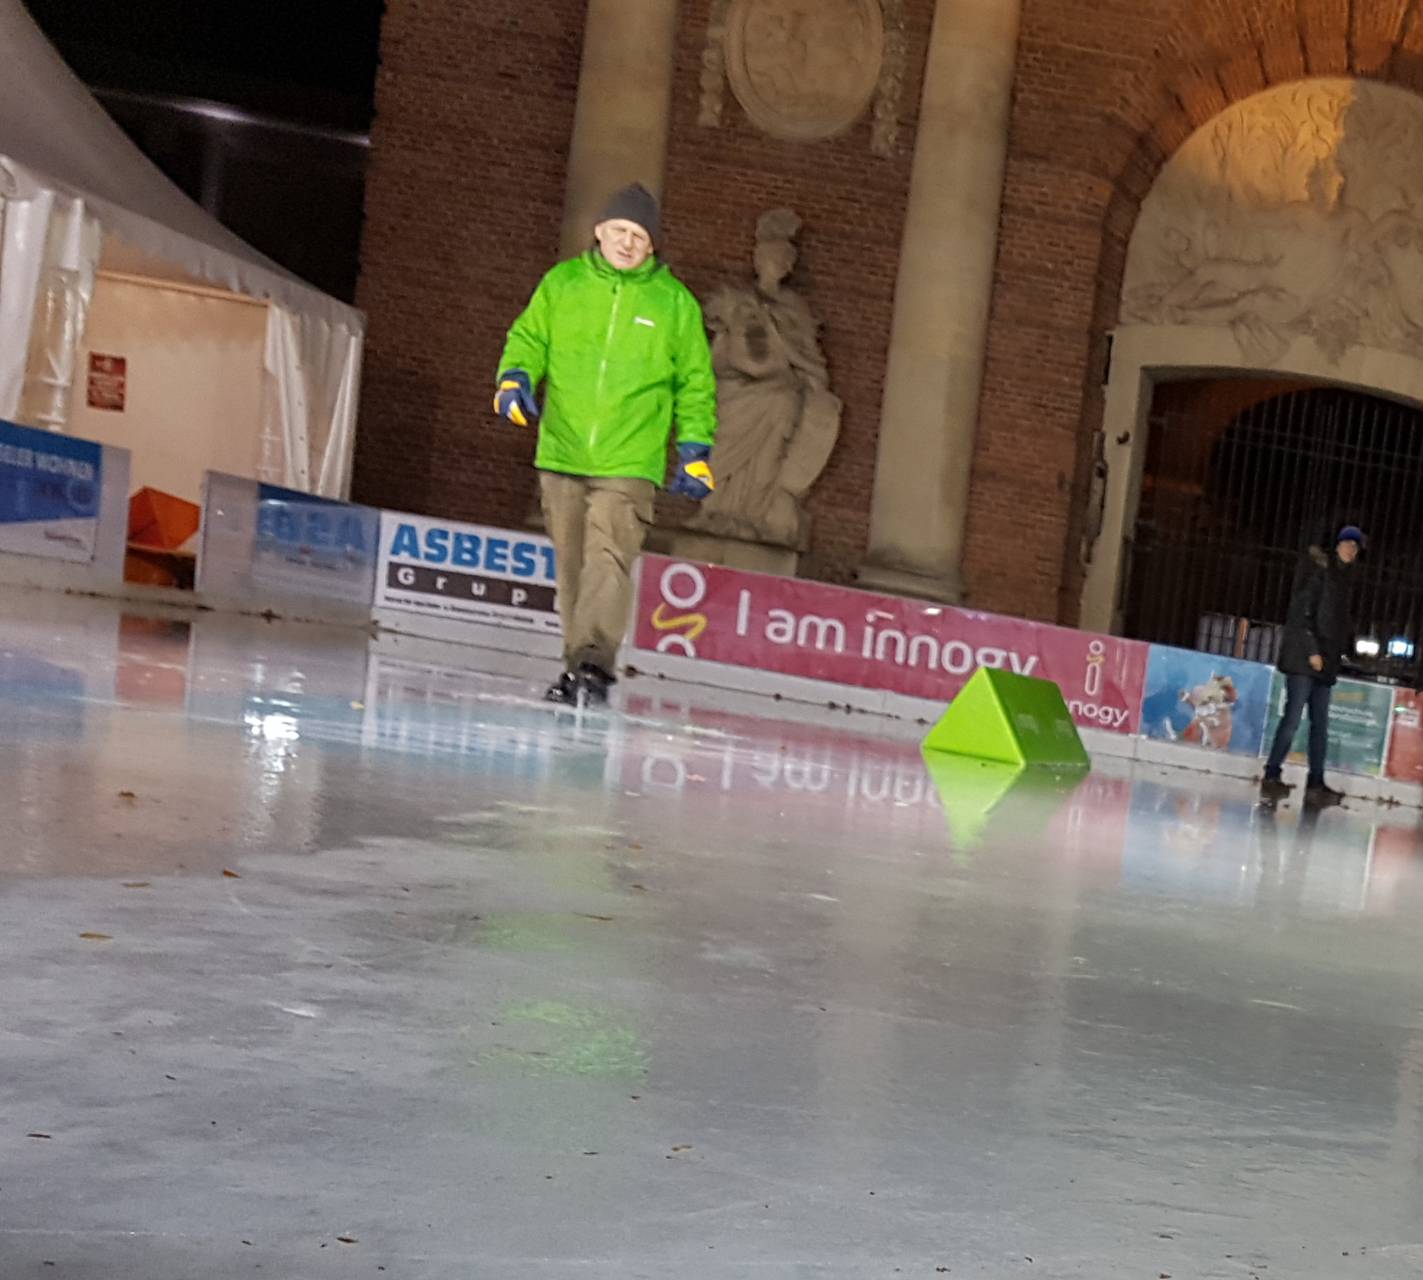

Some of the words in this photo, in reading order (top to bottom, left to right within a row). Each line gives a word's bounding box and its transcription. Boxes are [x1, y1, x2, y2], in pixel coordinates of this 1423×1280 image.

[397, 567, 560, 613] Grup
[736, 589, 751, 636] I
[764, 608, 845, 653] am
[1065, 699, 1129, 728] nogy
